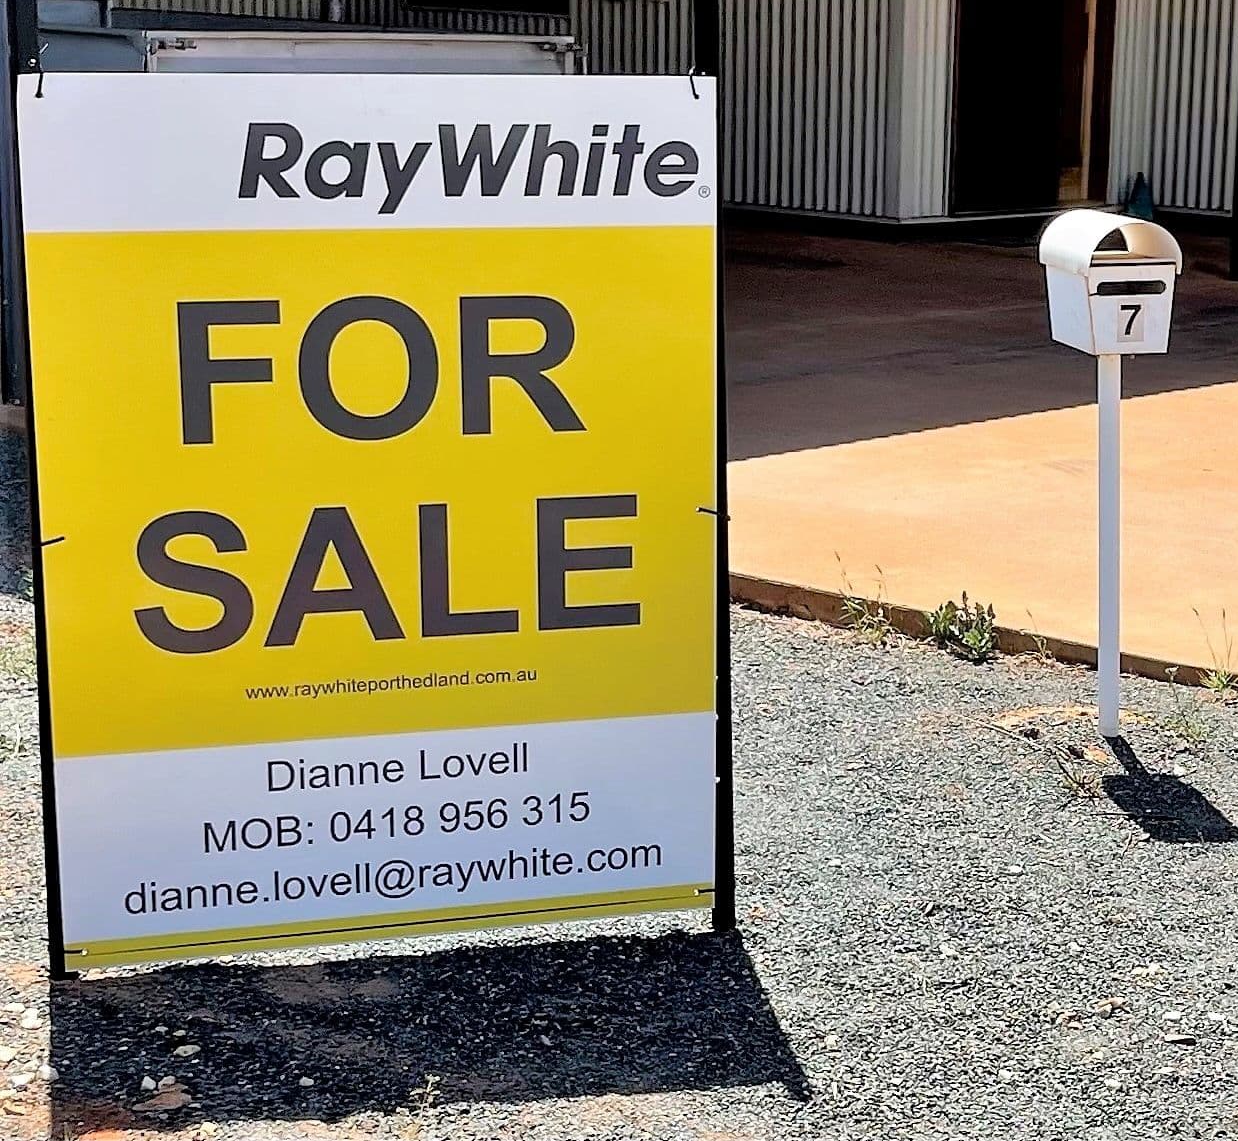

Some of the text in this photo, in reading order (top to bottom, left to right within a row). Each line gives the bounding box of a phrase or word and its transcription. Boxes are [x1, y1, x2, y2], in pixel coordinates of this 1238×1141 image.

[1120, 304, 1142, 336] 7
[176, 295, 588, 445] FOR
[133, 494, 642, 655] SALE
[245, 669, 538, 700] www.raywhiteporthedland.com.au
[267, 742, 528, 792] Dianne Lovell
[203, 791, 591, 854] MOB: 0418 956 315
[124, 844, 662, 915] dianne.lovell@raywhite.com
